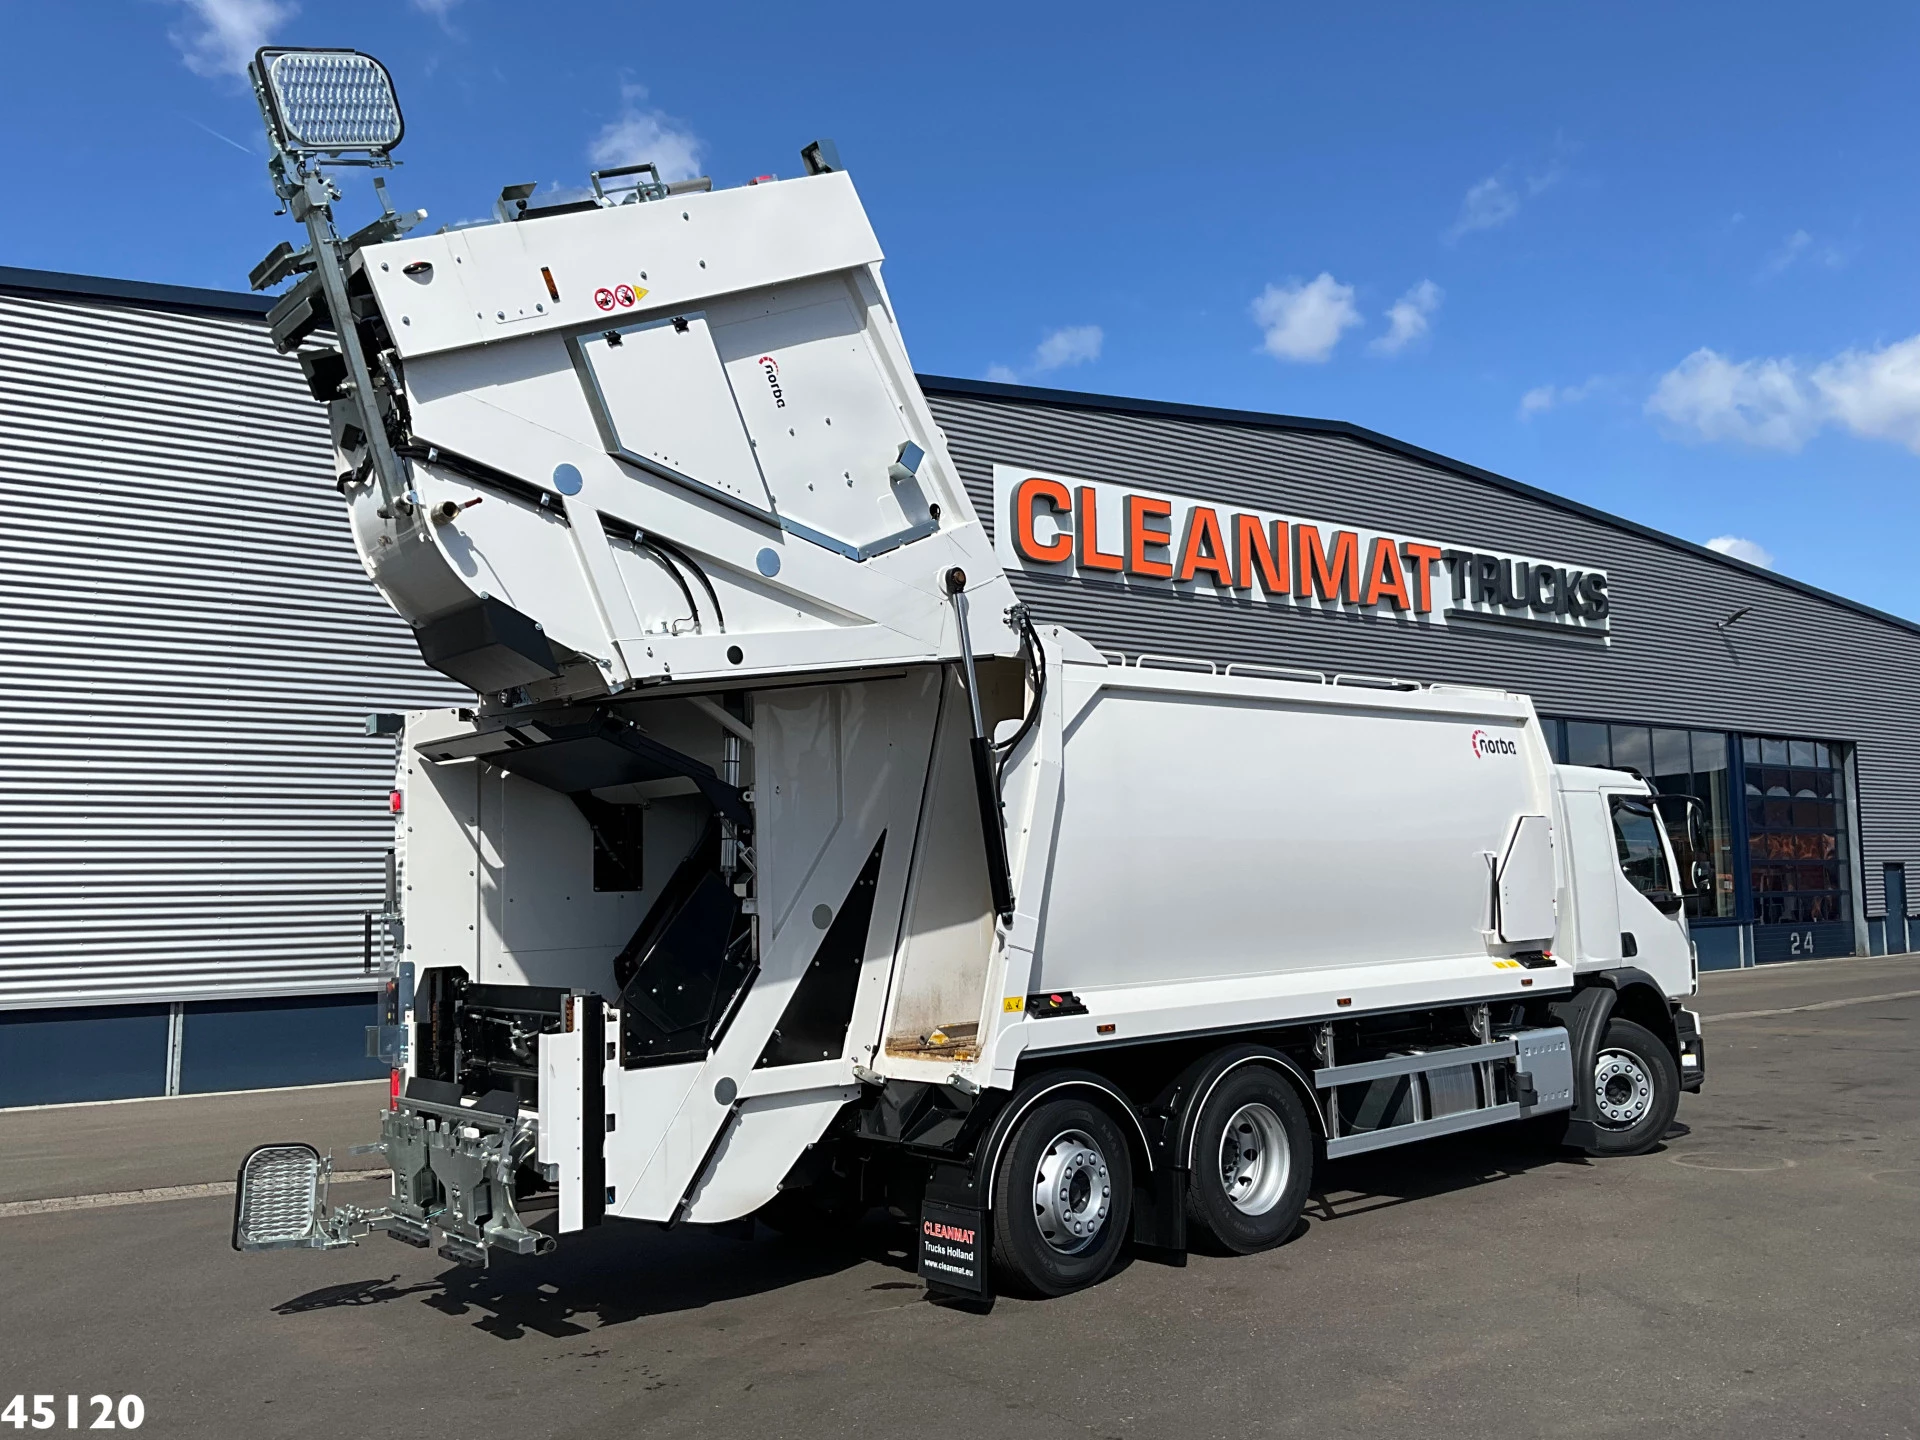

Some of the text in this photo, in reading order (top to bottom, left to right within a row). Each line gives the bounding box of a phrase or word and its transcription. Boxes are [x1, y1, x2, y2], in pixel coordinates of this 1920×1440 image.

[764, 364, 786, 408] norba
[1011, 477, 1609, 620] CLEANMAT TRUCKS
[1479, 737, 1517, 755] norba
[1790, 931, 1814, 955] 24
[923, 1220, 975, 1245] CLEANMAT
[924, 1240, 974, 1261] Trucks Holland
[924, 1258, 974, 1277] www.cleanmat.eu
